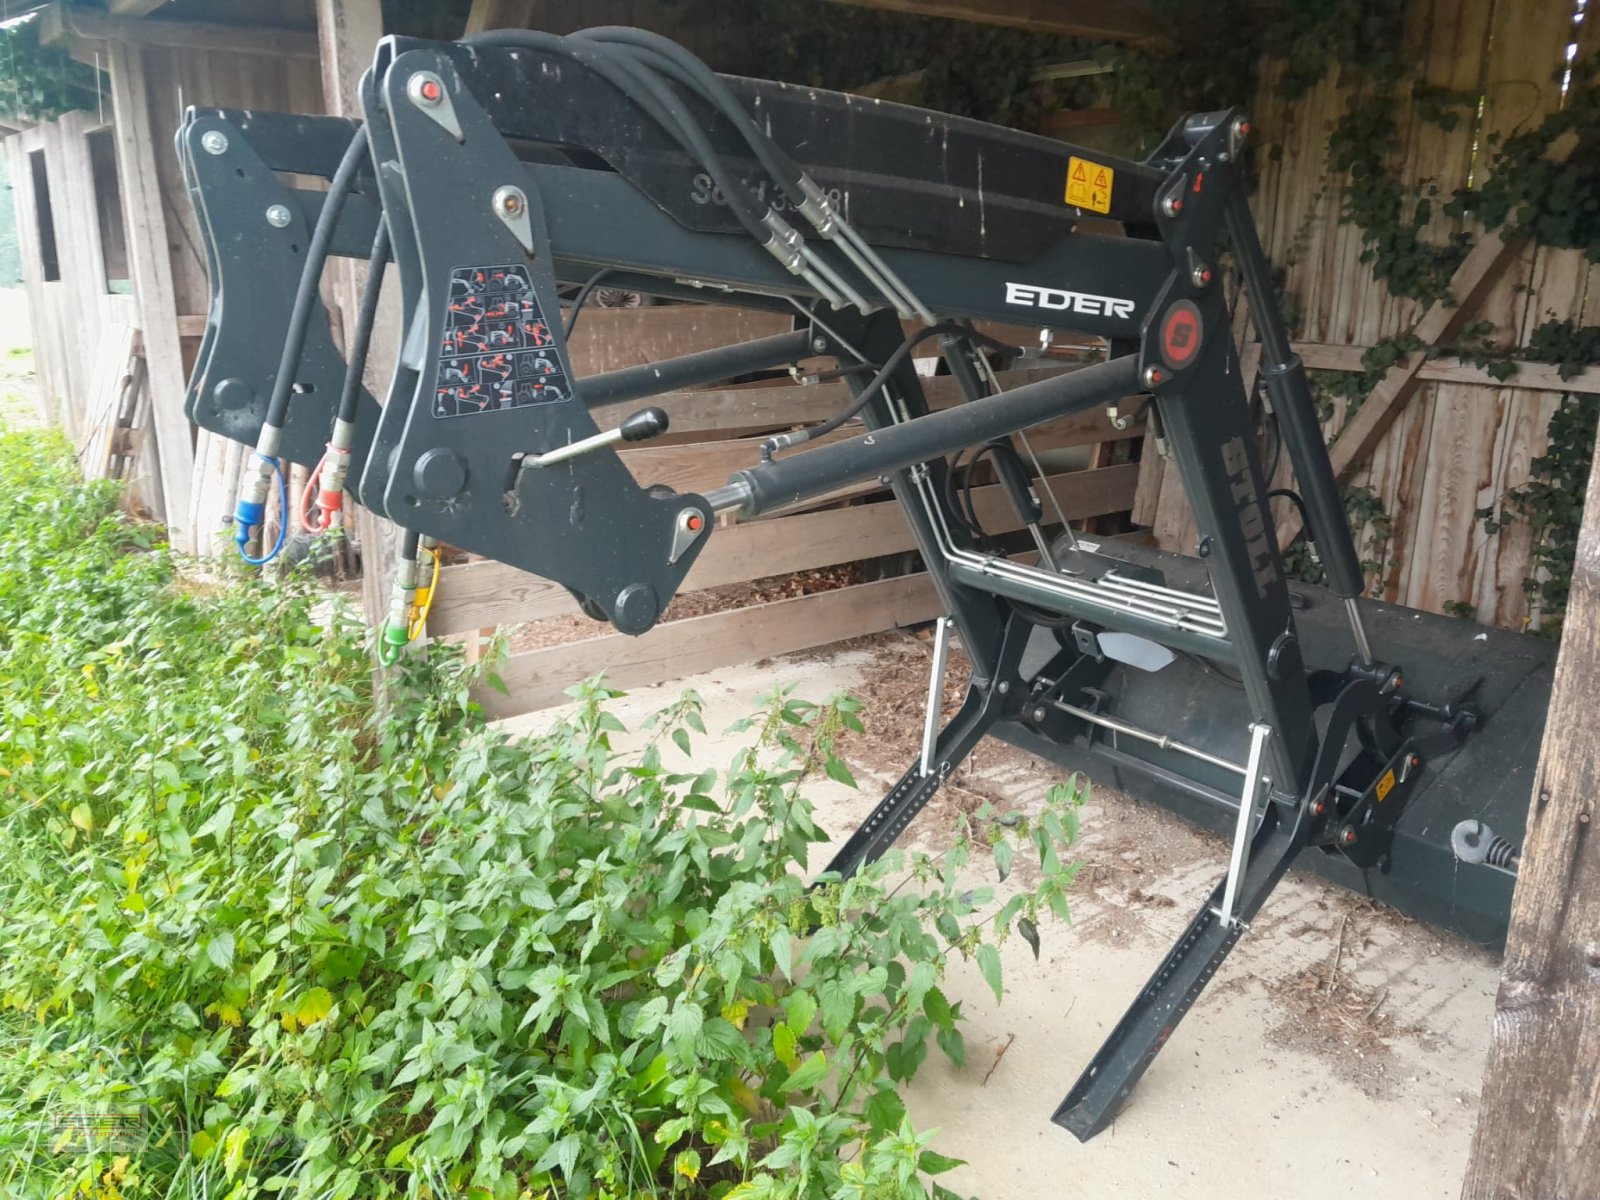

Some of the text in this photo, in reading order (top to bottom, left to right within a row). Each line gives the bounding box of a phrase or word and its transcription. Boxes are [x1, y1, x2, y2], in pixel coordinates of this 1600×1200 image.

[1005, 282, 1135, 319] EDER
[1171, 322, 1192, 348] S
[1221, 436, 1278, 600] STOLL
